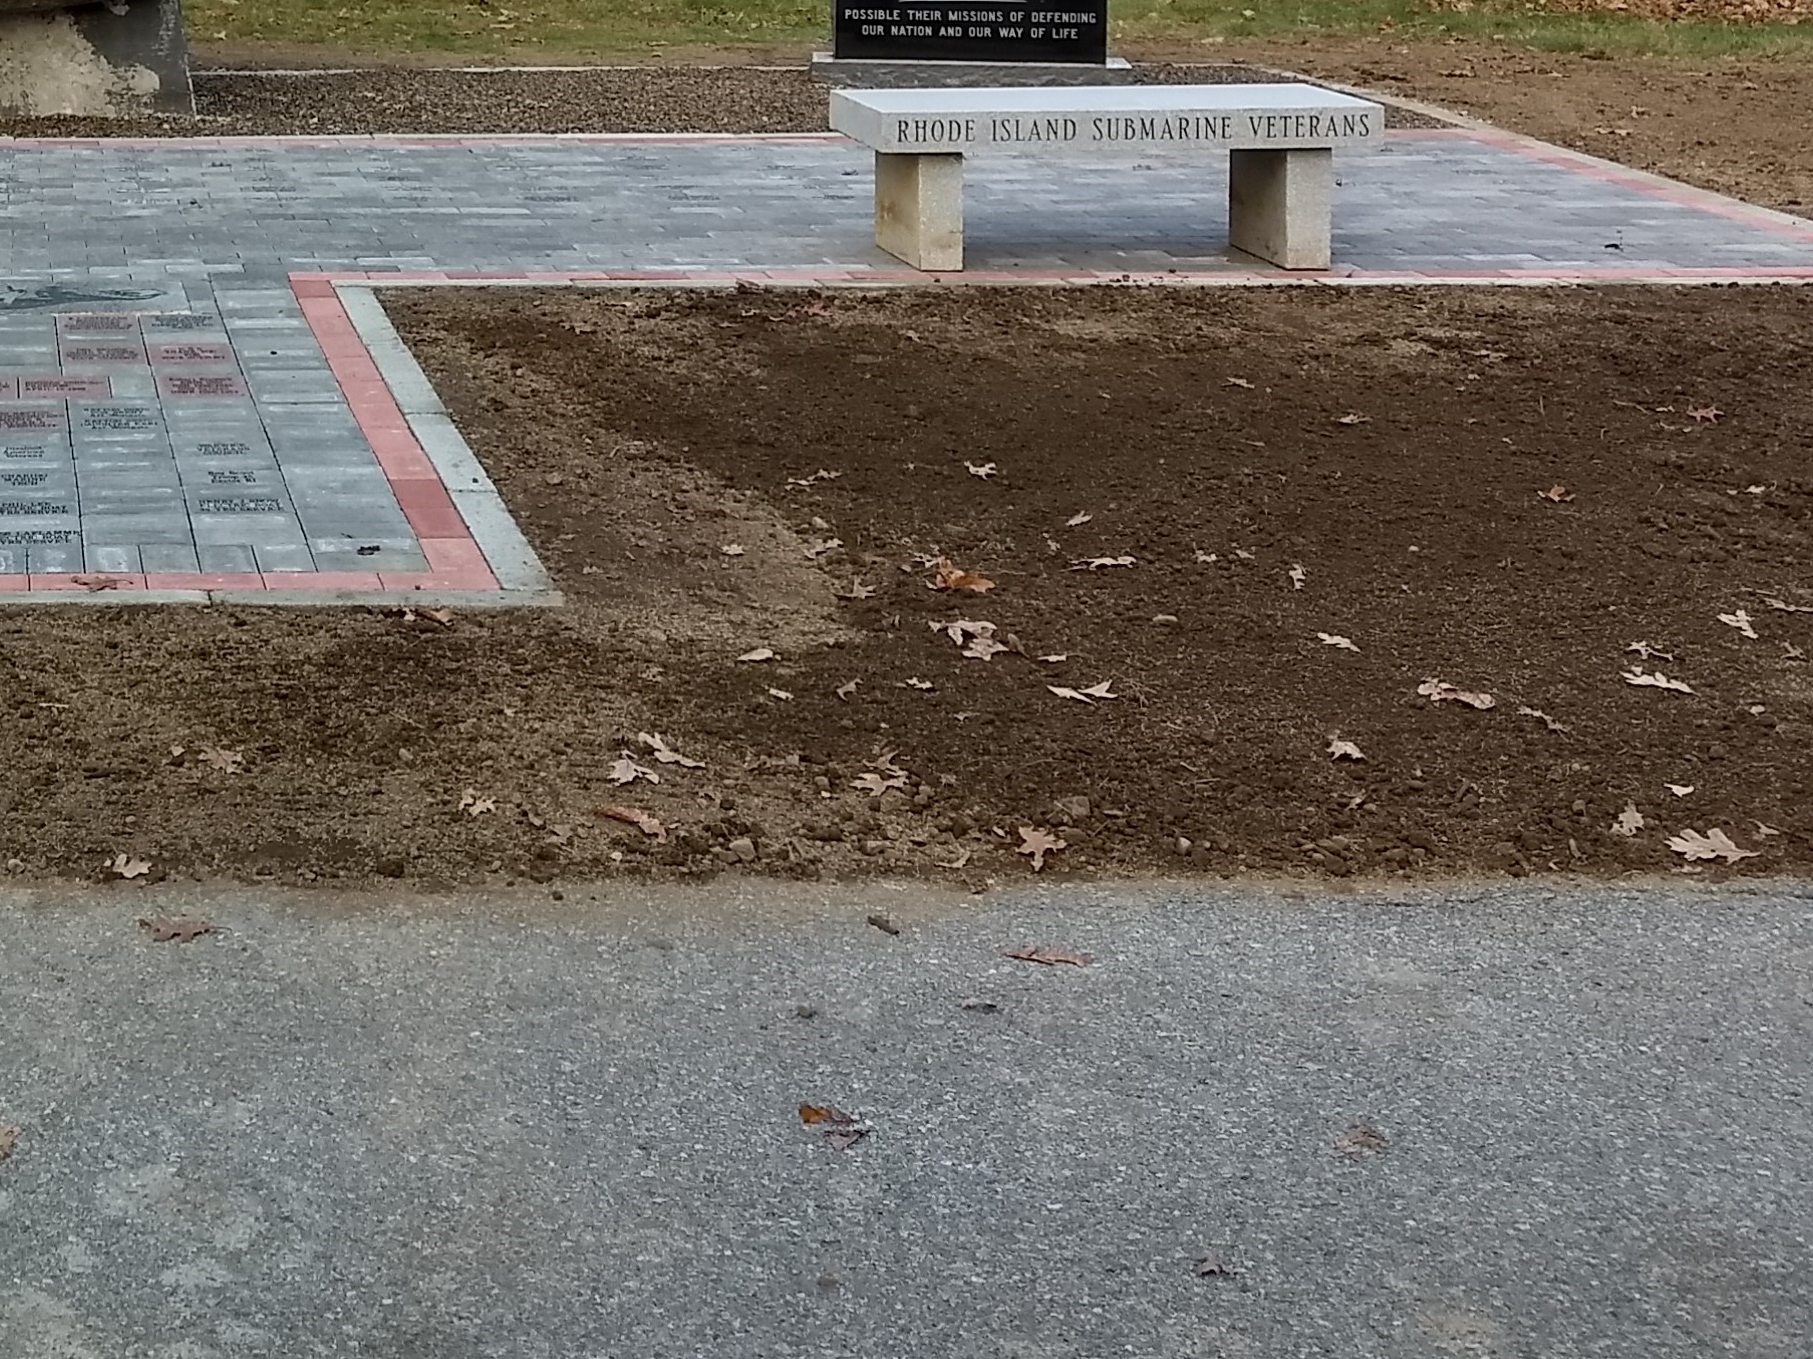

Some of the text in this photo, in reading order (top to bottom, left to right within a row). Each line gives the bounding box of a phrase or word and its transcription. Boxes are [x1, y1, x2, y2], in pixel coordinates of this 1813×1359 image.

[844, 9, 1097, 24] POSSIBLE THEIR MISSIONS OF DEFENDING
[861, 24, 1079, 40] OUR NATION AND OUR WAY OF LIFE
[897, 113, 1372, 143] RHODE ISLAND SUBMARINE VETERANS
